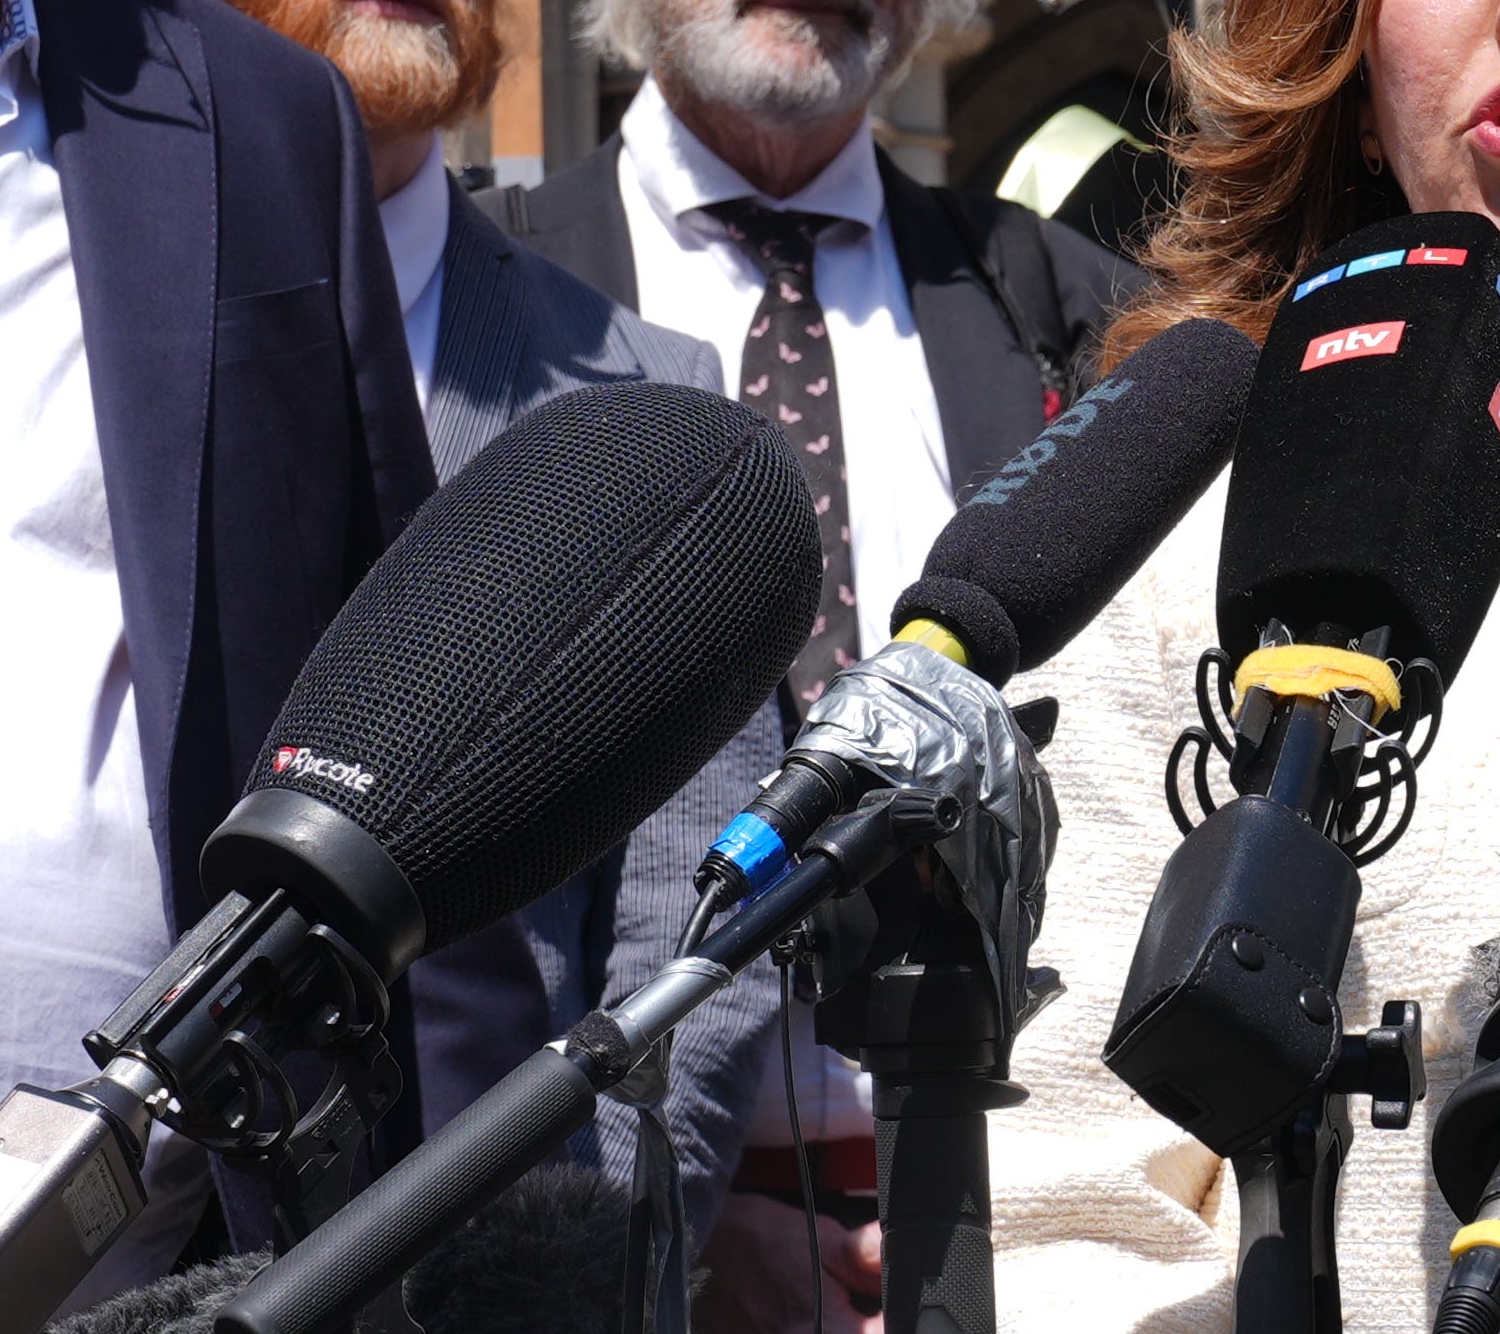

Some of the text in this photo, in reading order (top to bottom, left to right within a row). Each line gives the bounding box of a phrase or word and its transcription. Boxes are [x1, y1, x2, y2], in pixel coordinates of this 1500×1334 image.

[1306, 250, 1449, 292] RTL
[1315, 329, 1391, 360] ntv
[290, 746, 376, 793] Rycote
